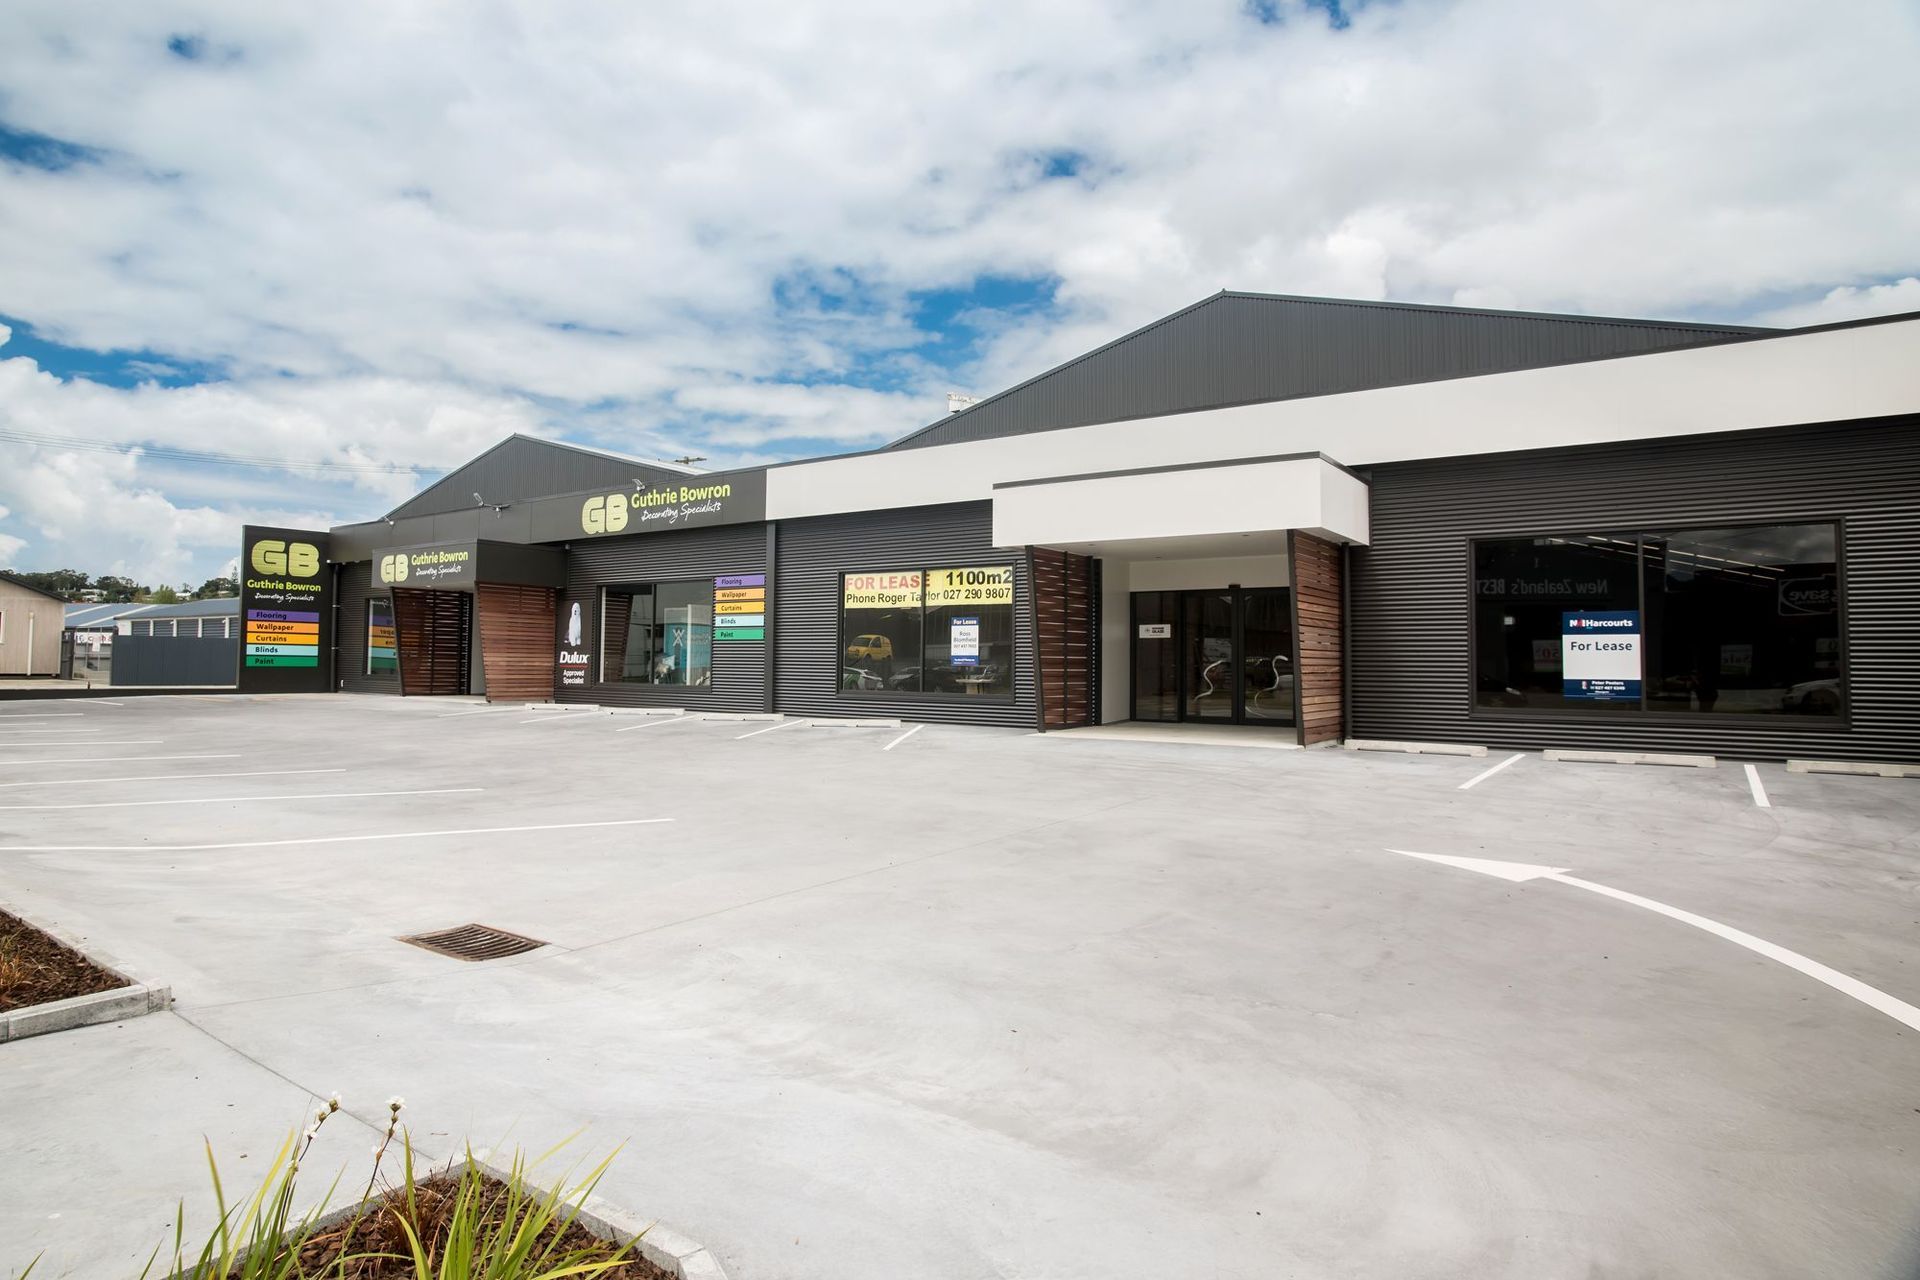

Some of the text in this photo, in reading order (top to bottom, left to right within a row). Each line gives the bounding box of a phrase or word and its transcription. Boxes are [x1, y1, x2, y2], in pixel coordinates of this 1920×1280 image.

[631, 484, 730, 508] Guthrie Bowron
[582, 494, 628, 535] GB
[641, 499, 722, 524] Decorating Specialists
[251, 539, 320, 578] GB
[411, 551, 468, 565] Guthrie Bowron
[380, 554, 408, 583] GB
[247, 579, 321, 592] Guthrie Bowron
[721, 578, 743, 586] Flooring
[845, 576, 875, 591] FOR
[946, 569, 1012, 586] 1100m2
[846, 587, 1011, 605] Phone Roger Talor 027 290 9807
[256, 612, 287, 620] Flooring
[256, 623, 294, 631] Wallpaper
[1586, 619, 1633, 627] Harcourts
[1571, 641, 1633, 651] For Lease
[559, 651, 588, 664] Dulux
[563, 669, 585, 677] Approved
